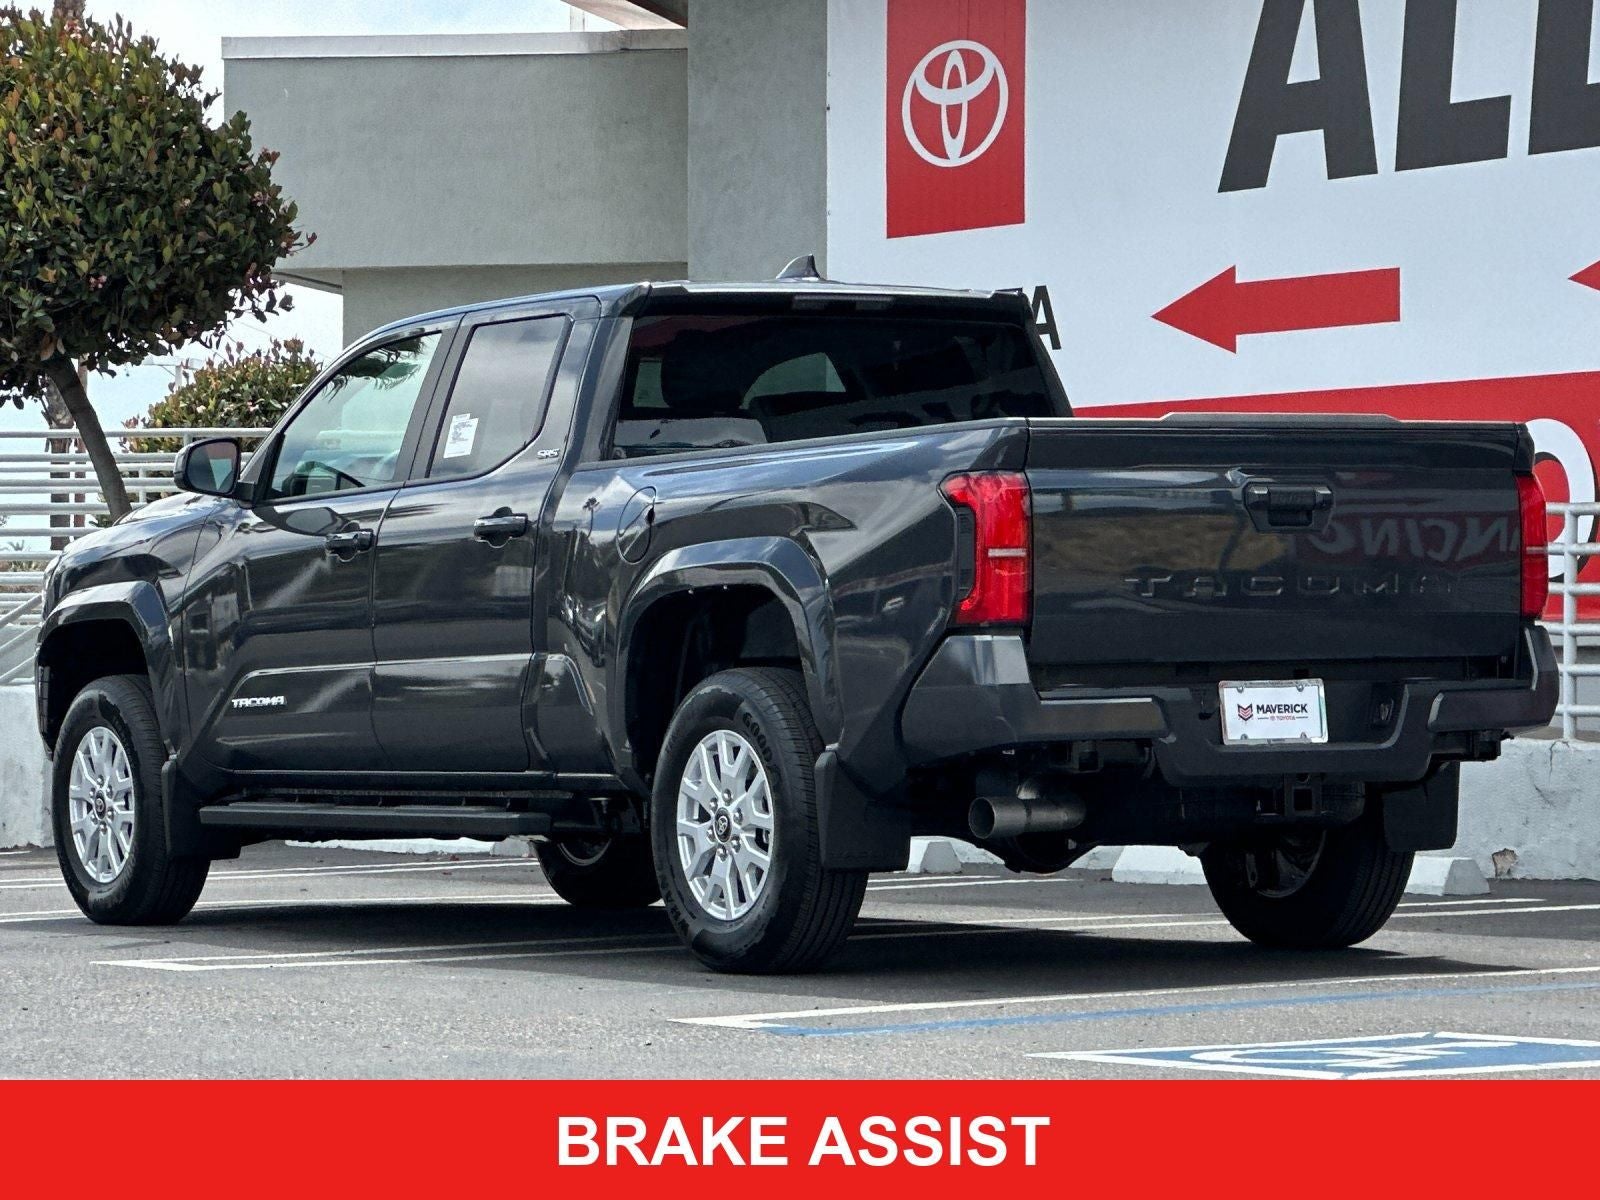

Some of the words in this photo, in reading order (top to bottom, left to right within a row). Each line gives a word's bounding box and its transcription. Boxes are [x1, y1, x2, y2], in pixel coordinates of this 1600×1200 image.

[1123, 574, 1452, 598] TACOMA
[231, 695, 286, 708] TACOMA
[1256, 703, 1308, 714] MAVERICK
